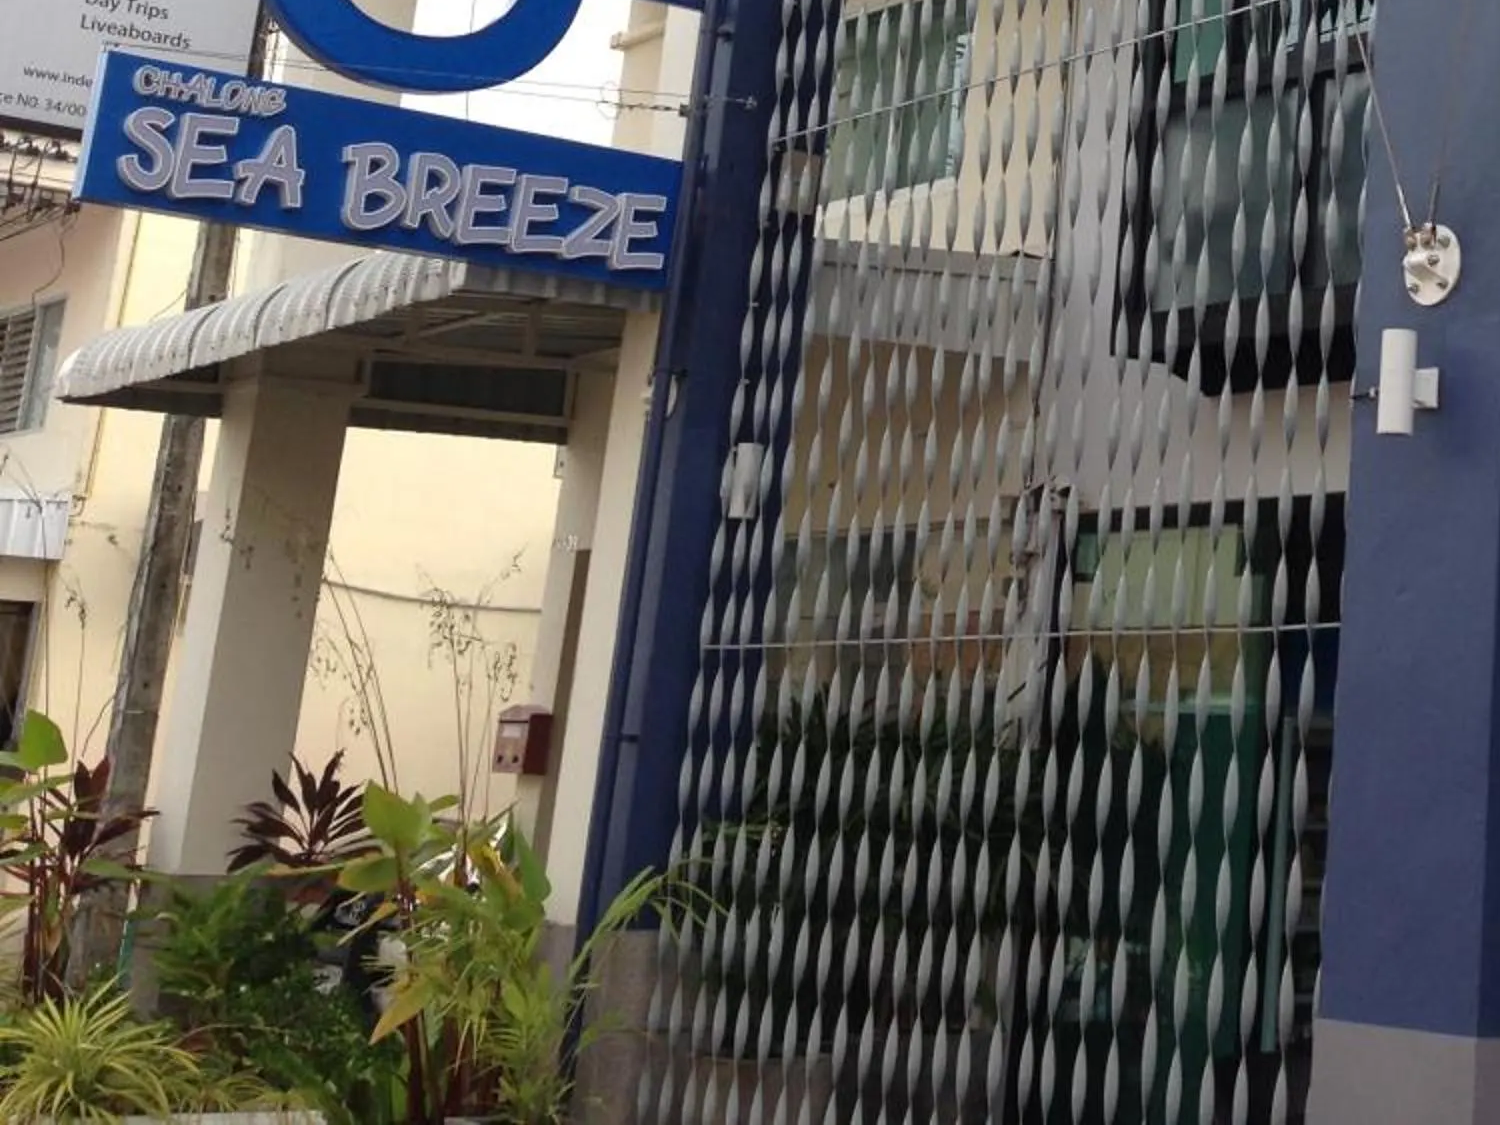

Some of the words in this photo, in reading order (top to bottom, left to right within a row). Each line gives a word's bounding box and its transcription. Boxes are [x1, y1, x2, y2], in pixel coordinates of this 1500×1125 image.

[80, 14, 192, 49] Liveaboards
[132, 64, 287, 117] CHALONG
[117, 106, 305, 209] SEA
[341, 141, 668, 271] BREEZE
